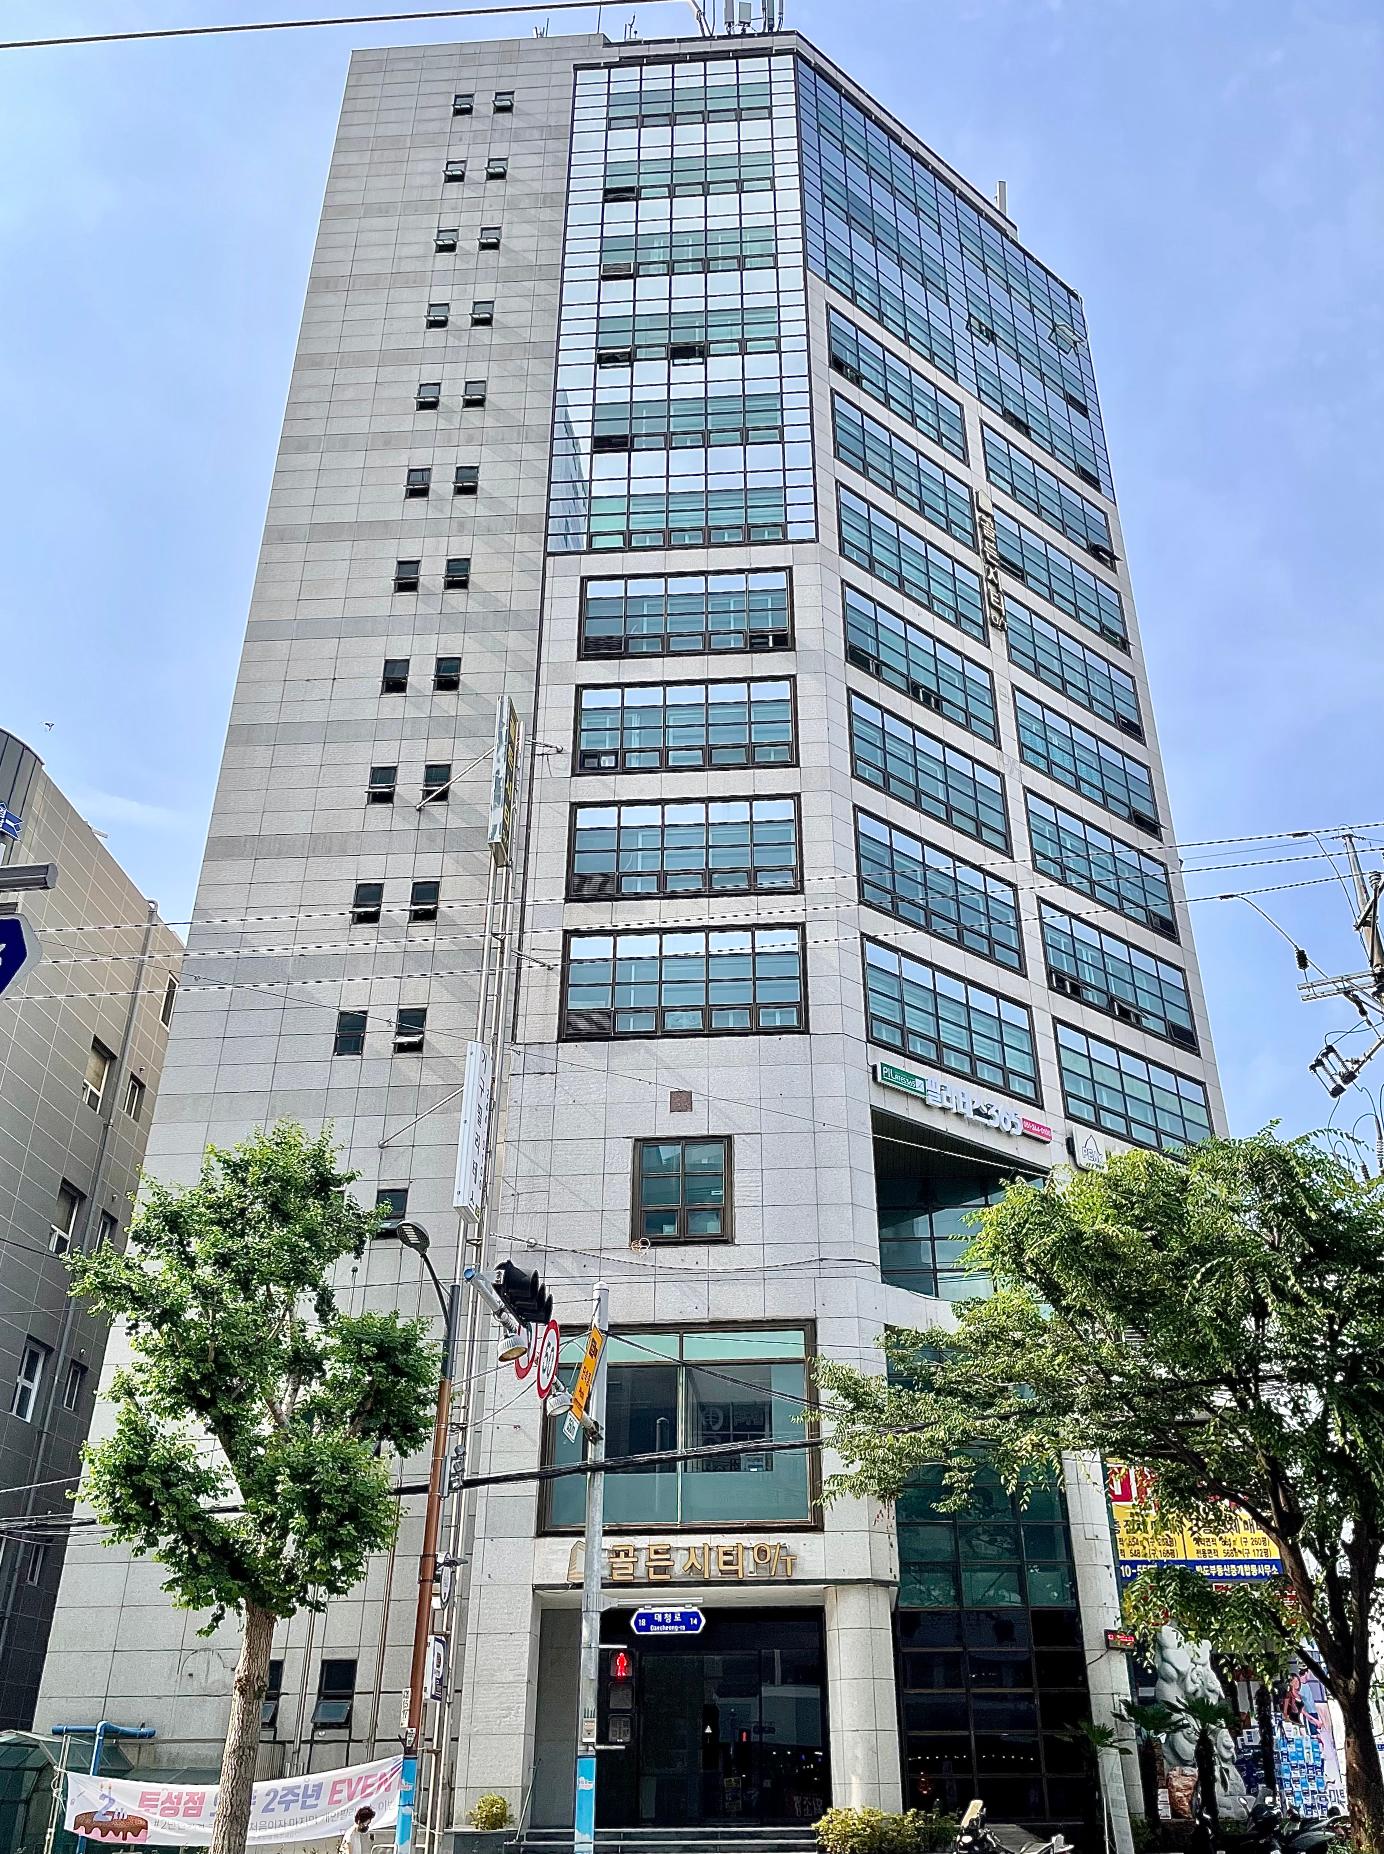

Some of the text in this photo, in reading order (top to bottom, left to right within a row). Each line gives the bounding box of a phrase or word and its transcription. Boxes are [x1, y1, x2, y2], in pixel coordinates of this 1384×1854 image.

[638, 1617, 698, 1627] 18 14
[654, 1613, 681, 1624] 대청로
[261, 1782, 324, 1813] 2주년
